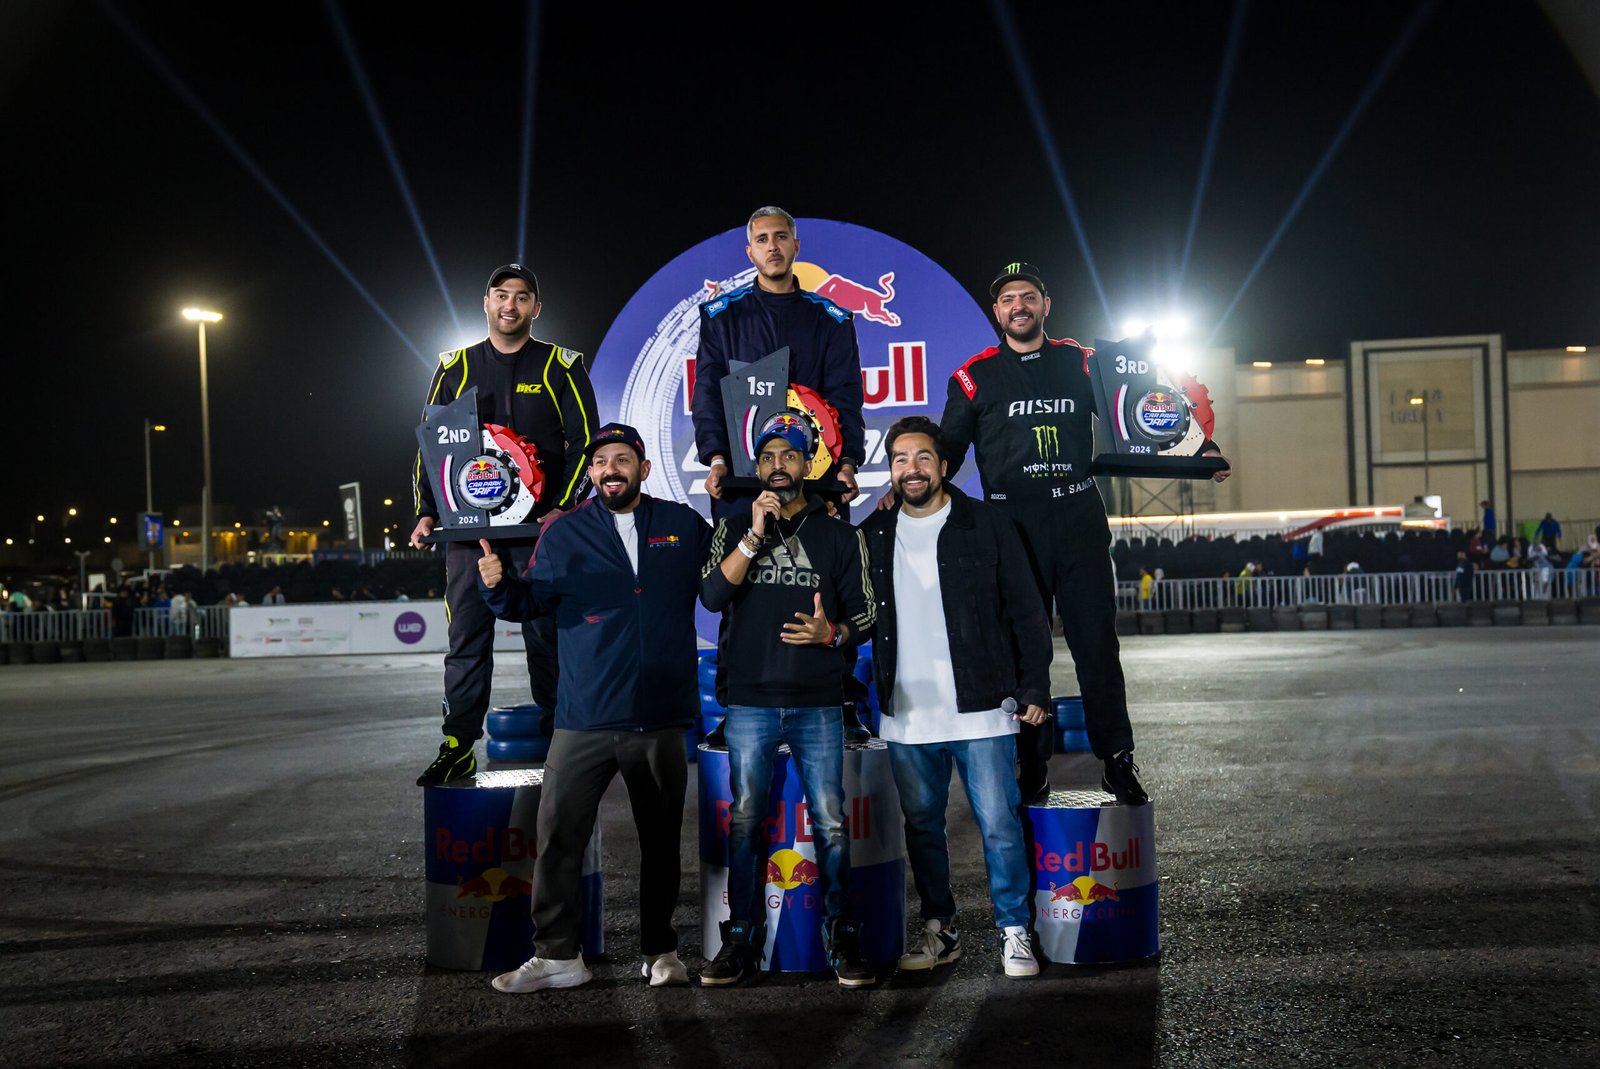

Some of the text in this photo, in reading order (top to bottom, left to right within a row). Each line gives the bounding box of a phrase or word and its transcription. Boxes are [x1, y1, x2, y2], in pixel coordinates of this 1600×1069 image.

[828, 306, 843, 316] OMP
[1116, 355, 1149, 374] 3RD
[861, 344, 926, 406] ull
[747, 376, 775, 396] 1ST
[1008, 399, 1075, 417] AISIN
[1144, 403, 1177, 412] Red Bull
[1144, 418, 1178, 427] DRIFT
[437, 426, 470, 444] 2ND
[1130, 446, 1151, 454] 2024
[467, 470, 500, 480] Red Bull
[468, 486, 503, 496] DRIFT
[458, 516, 479, 525] 2024
[747, 565, 821, 589] adidas
[715, 796, 871, 844] Rd Bll
[434, 825, 496, 863] Red
[1089, 837, 1140, 872] Bull
[1040, 907, 1093, 920] NERGY
